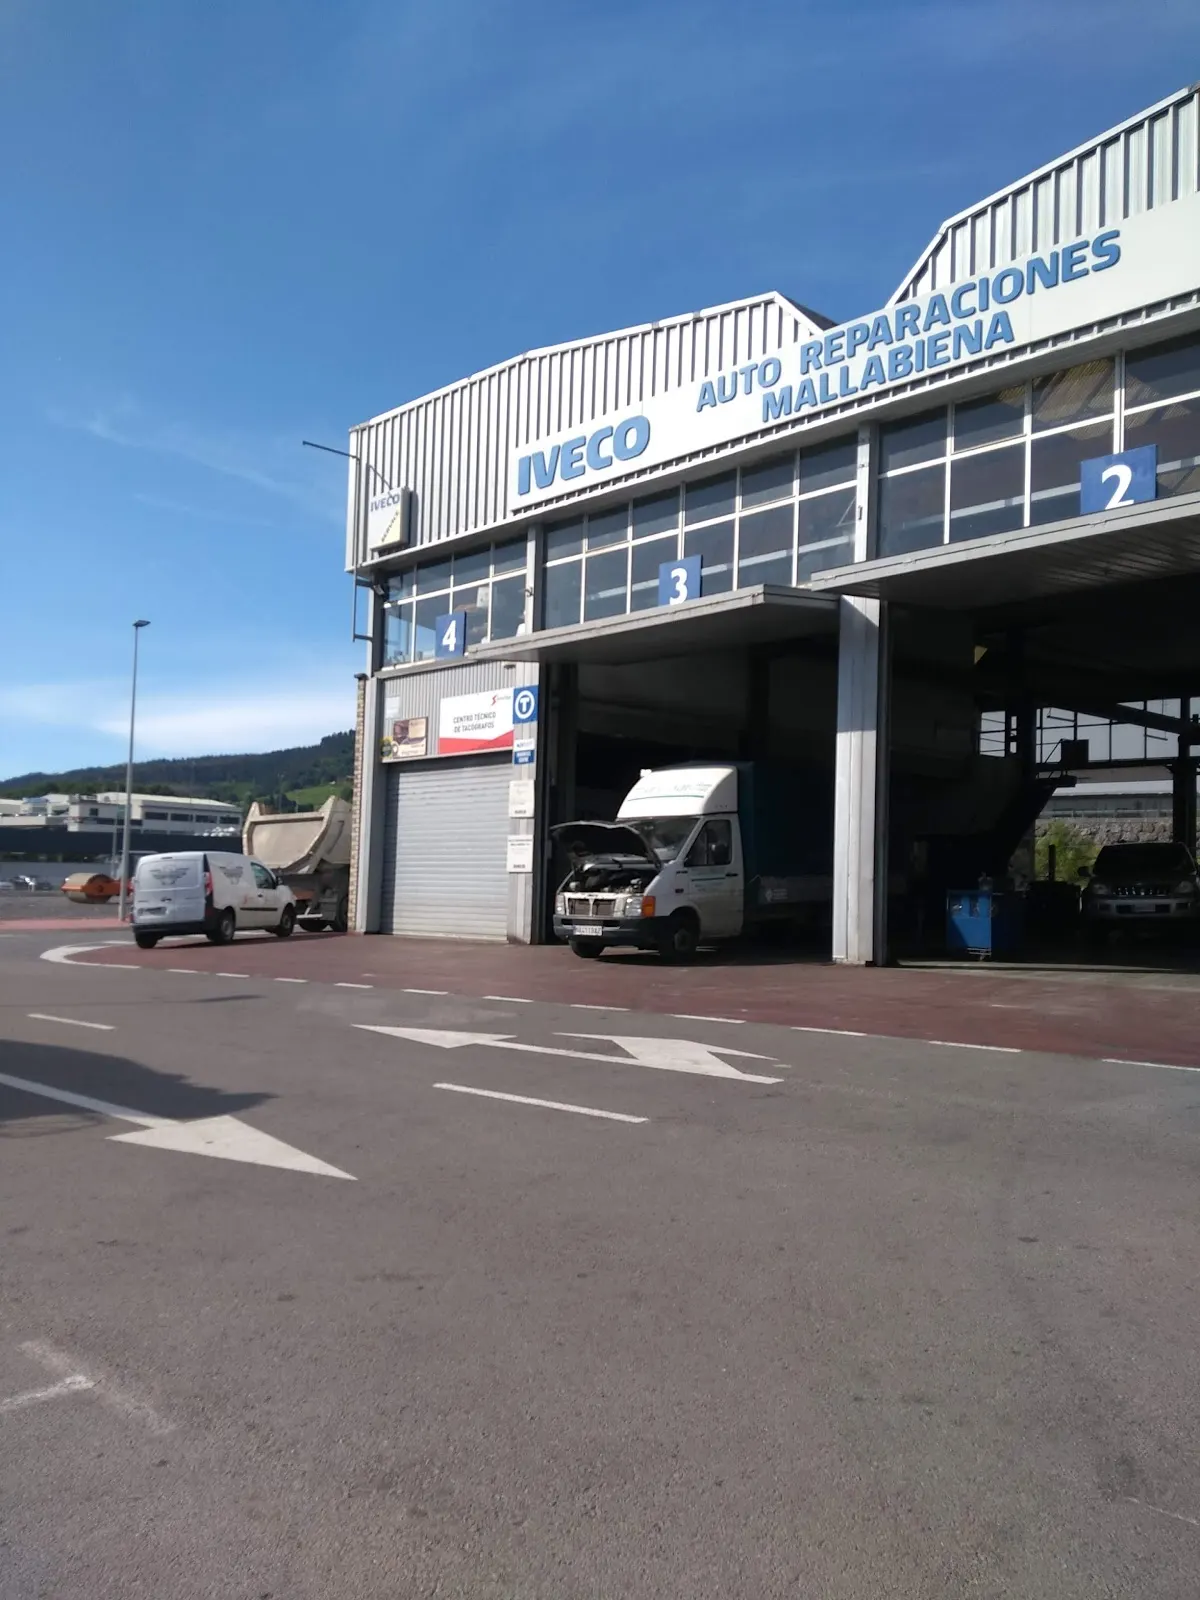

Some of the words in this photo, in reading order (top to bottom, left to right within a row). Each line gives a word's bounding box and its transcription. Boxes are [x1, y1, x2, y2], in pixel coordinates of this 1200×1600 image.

[696, 357, 782, 412] AUTO
[800, 229, 1121, 375] REPARACIONES
[762, 310, 1015, 423] MALLABIENA
[518, 415, 650, 496] IVECO
[370, 492, 400, 512] IVECO
[1101, 464, 1134, 510] 2
[669, 568, 687, 605] 3
[442, 620, 456, 651] 4
[453, 714, 473, 724] CENTRO
[519, 697, 530, 713] T
